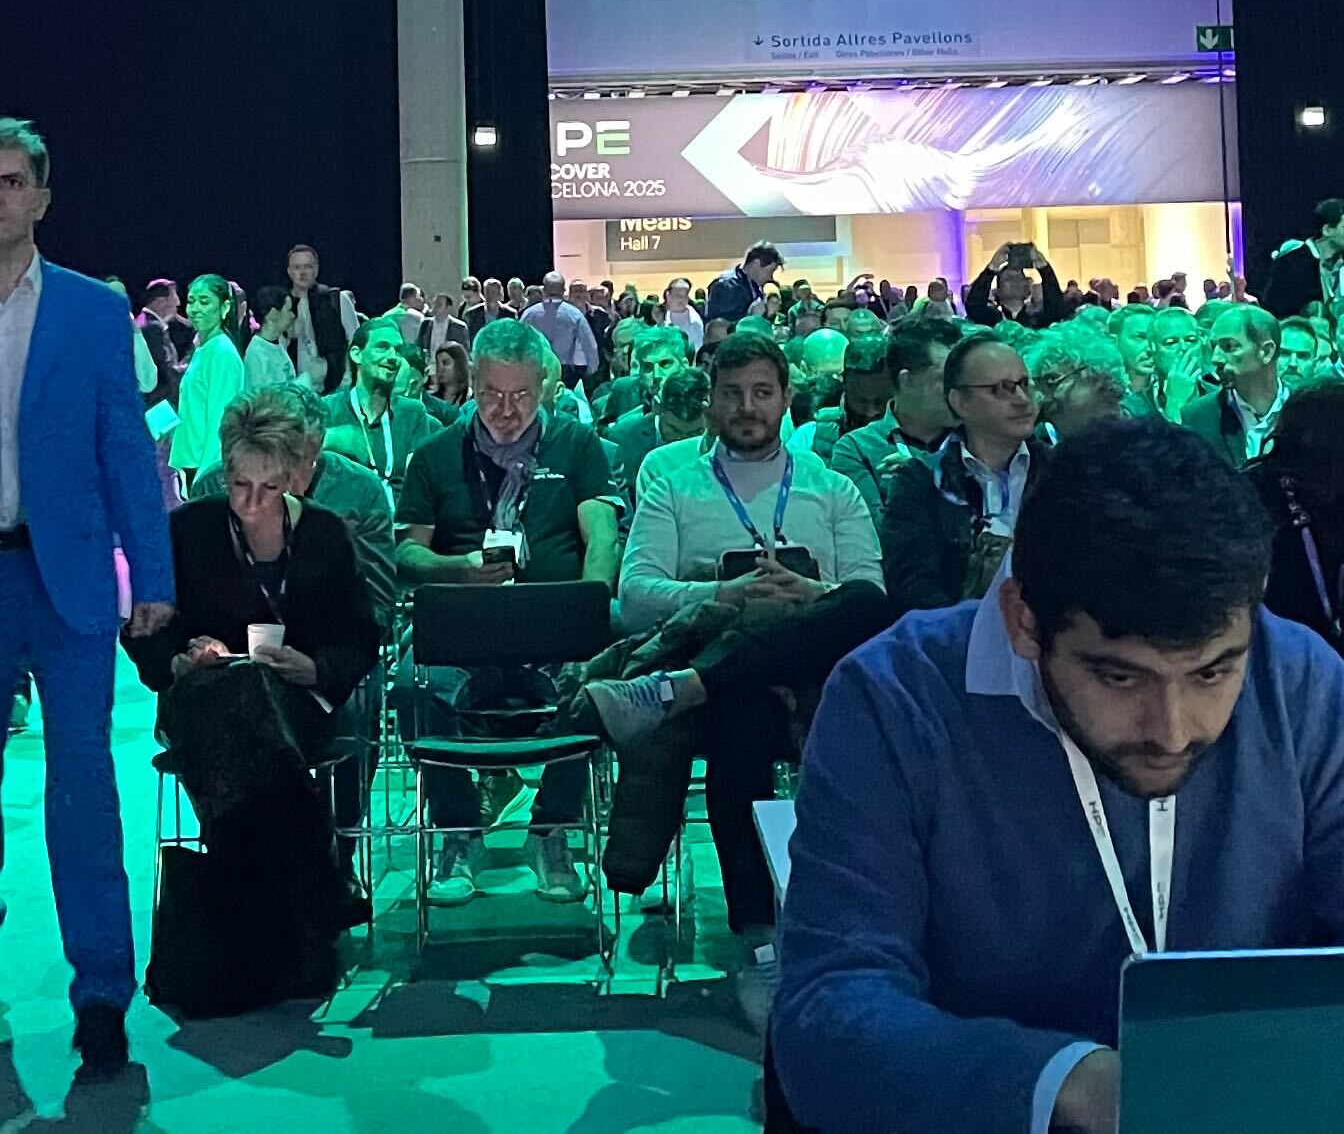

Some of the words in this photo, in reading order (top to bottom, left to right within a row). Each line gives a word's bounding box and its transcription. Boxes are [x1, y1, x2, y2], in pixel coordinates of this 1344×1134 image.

[771, 34, 830, 48] Sortida
[836, 33, 887, 46] Altres
[892, 31, 973, 45] Pavellons
[623, 179, 667, 197] 2025
[620, 235, 649, 251] Hall
[651, 235, 661, 250] 7
